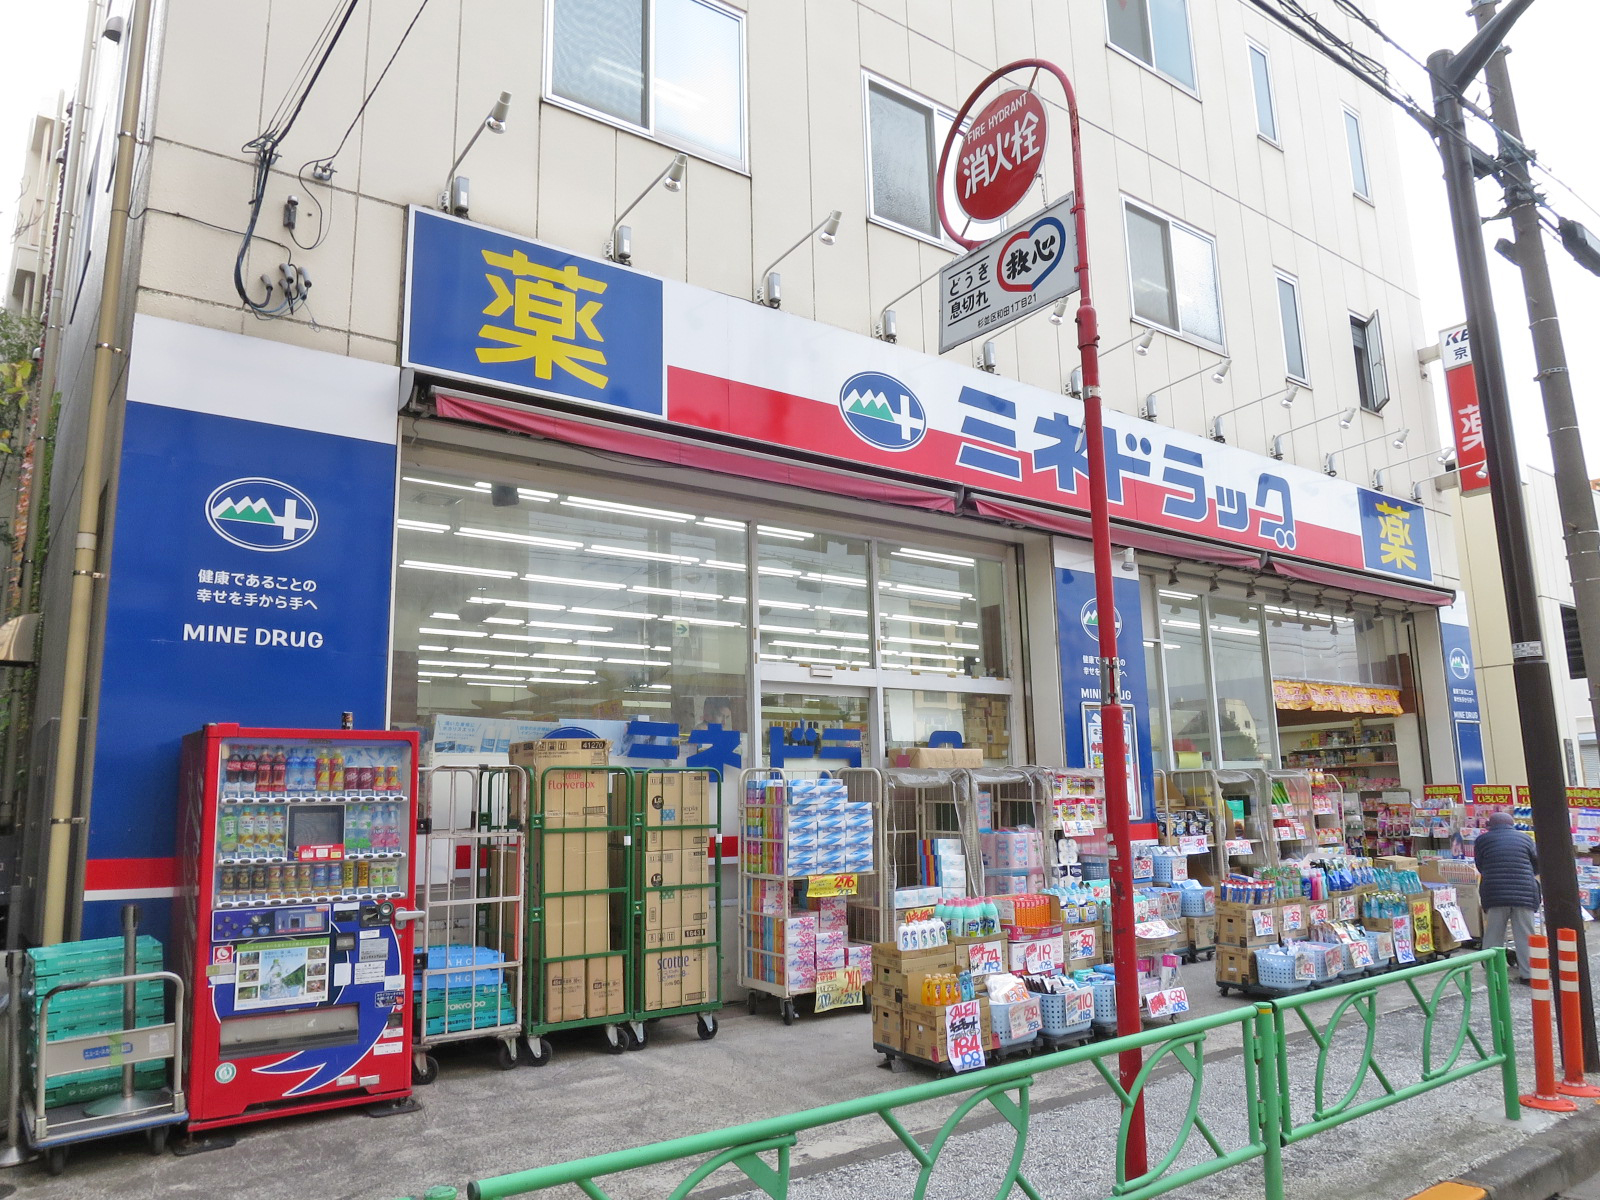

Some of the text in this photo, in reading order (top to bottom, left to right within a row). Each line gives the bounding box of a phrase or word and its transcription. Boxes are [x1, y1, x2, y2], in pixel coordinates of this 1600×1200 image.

[967, 91, 1028, 144] FIRE HYDRANT
[962, 111, 1040, 199] 消火栓
[1006, 235, 1056, 280] 救心
[950, 263, 989, 297] どうき
[475, 248, 608, 390] 薬
[950, 290, 989, 320] 息切れ
[956, 385, 1297, 551] ミネドラッグ
[1375, 500, 1417, 571] 薬
[197, 569, 317, 592] 健康であることの
[196, 588, 318, 611] 幸せを手から手へ
[183, 623, 324, 649] MINE DRUG
[582, 741, 604, 749] 41270
[834, 875, 855, 889] 276
[952, 1035, 980, 1058] 184
